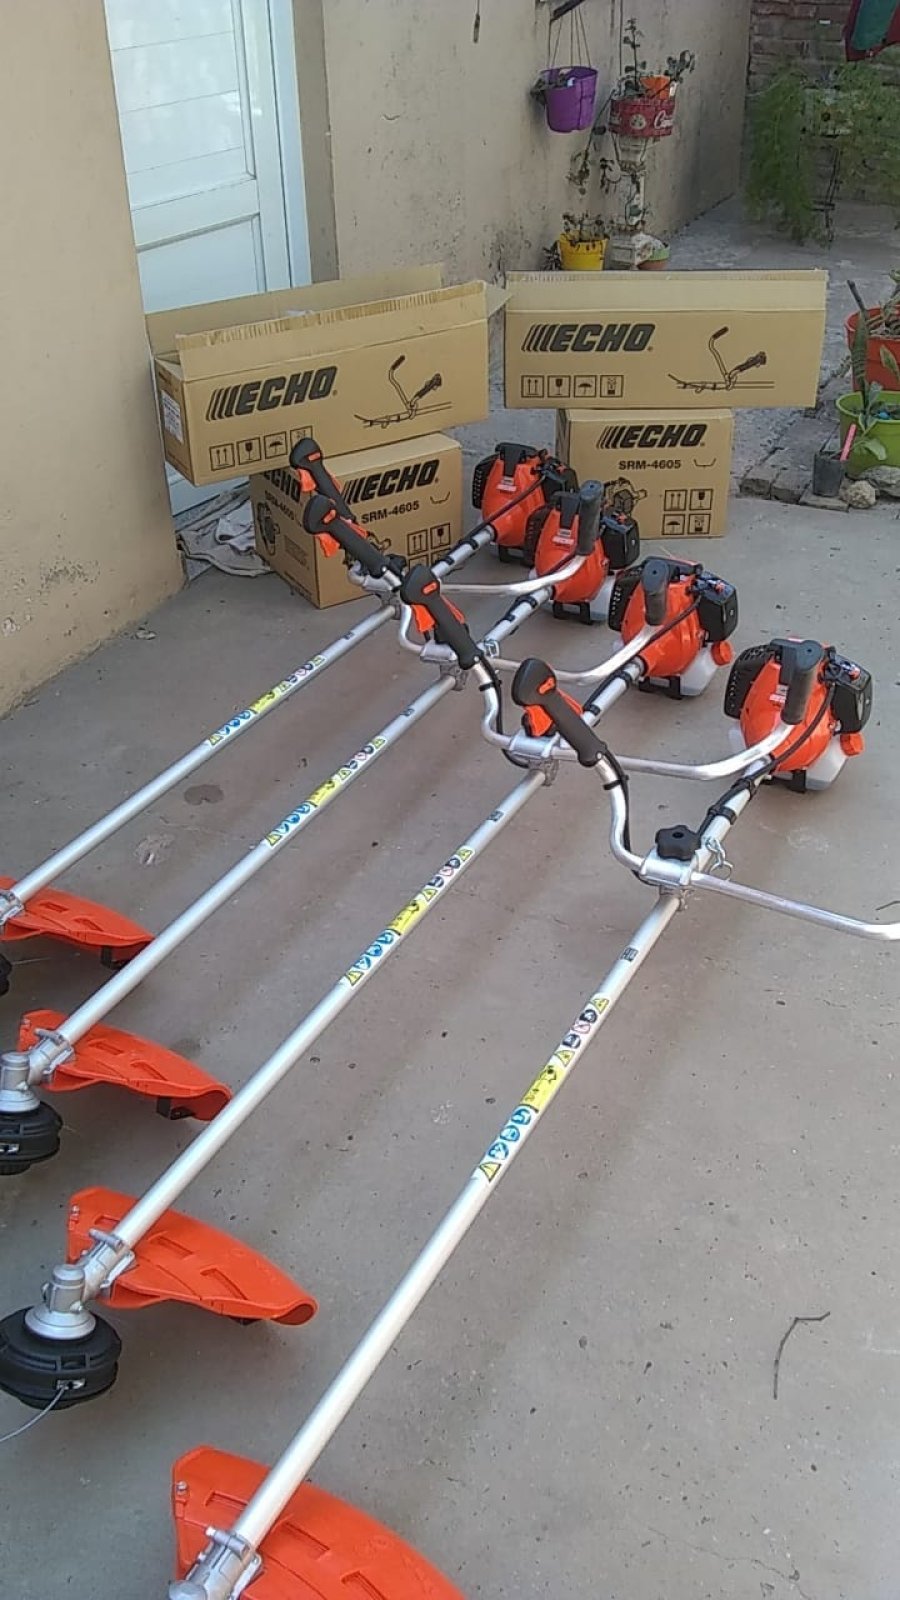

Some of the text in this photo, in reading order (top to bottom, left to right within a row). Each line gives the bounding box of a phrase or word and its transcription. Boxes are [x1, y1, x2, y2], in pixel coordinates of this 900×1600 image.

[550, 323, 656, 352] ECHO
[234, 365, 338, 416] ECHO
[619, 423, 708, 449] ECHO
[618, 459, 682, 471] SRM-4605
[359, 459, 440, 501] ECHO
[361, 500, 420, 524] SRM-4605
